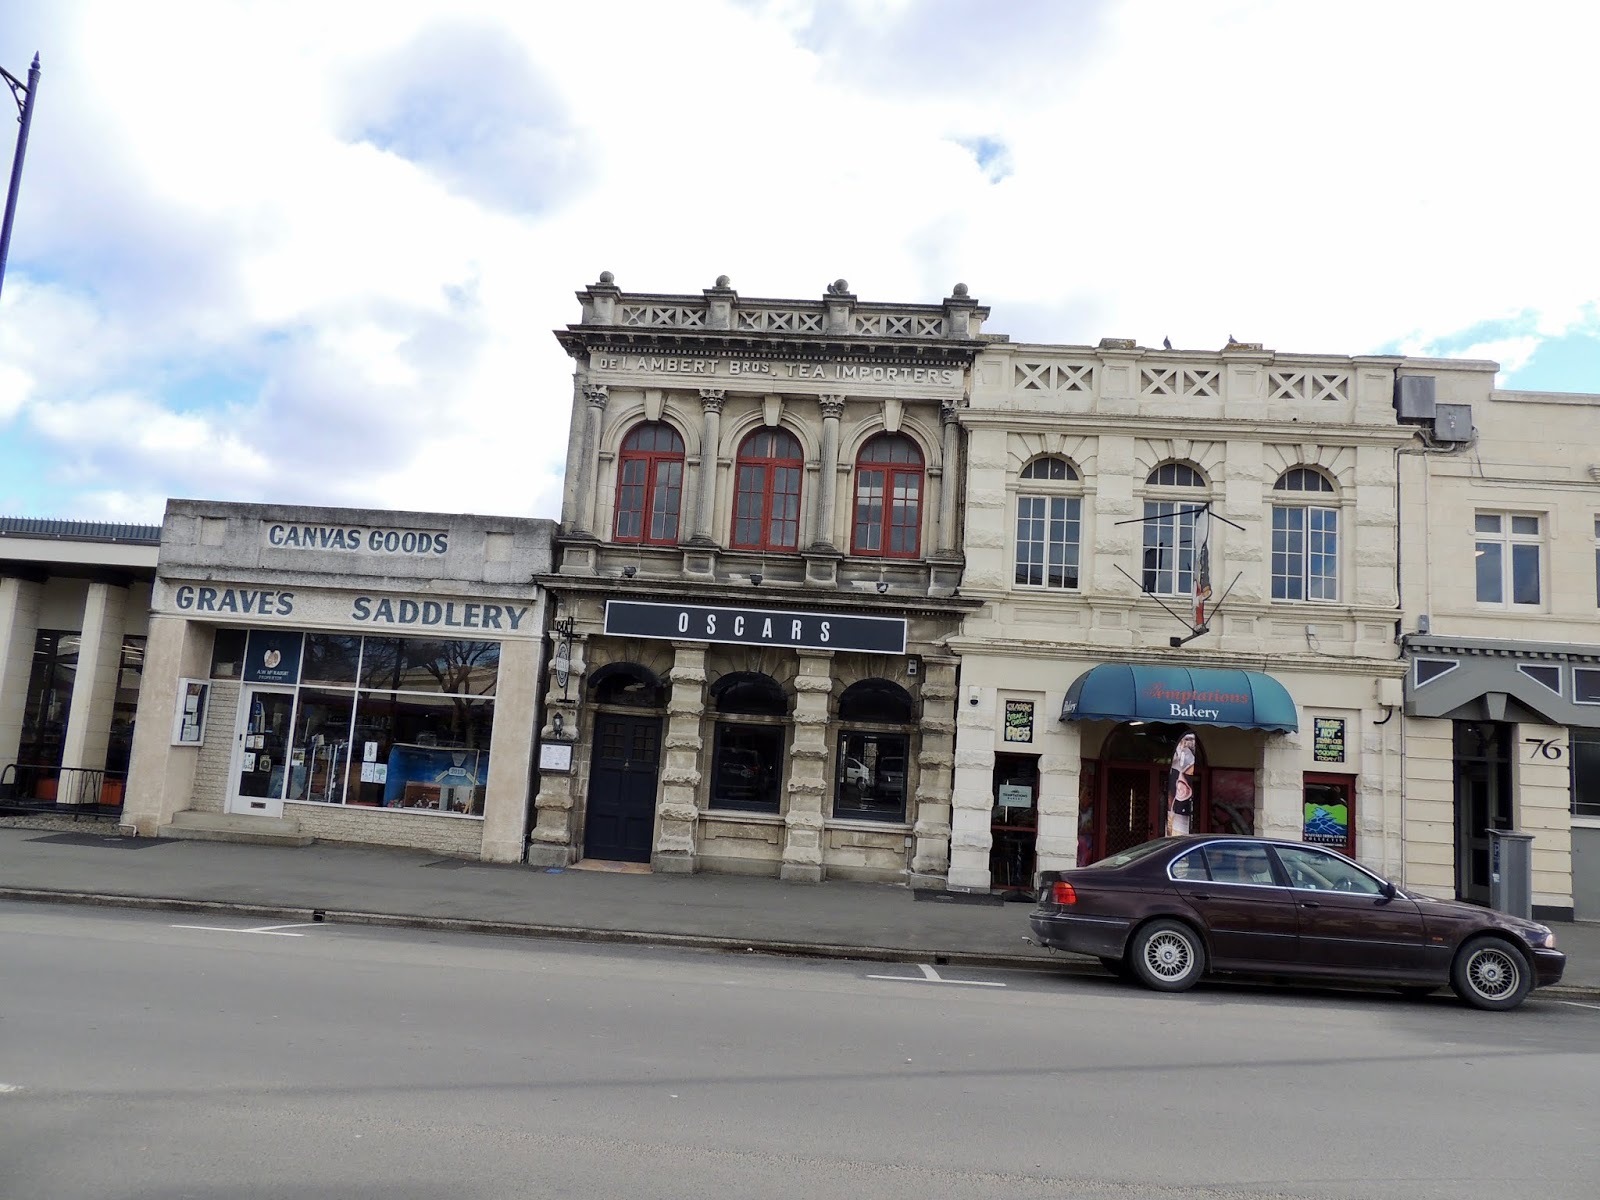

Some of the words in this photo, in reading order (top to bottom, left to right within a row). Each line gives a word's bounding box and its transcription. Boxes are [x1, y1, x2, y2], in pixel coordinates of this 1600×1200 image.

[785, 363, 826, 379] TEA
[836, 365, 954, 385] IMPORTERS
[269, 524, 362, 551] CANVAS
[368, 529, 449, 555] GOODS
[175, 585, 295, 617] GRAVE'S
[351, 596, 528, 630] SADDLERY
[677, 612, 831, 643] OSCARS
[1143, 681, 1249, 705] Temptations
[1170, 702, 1220, 721] Bakery
[1005, 726, 1031, 741] PIES
[1320, 728, 1338, 739] NOT
[1525, 738, 1562, 760] 76
